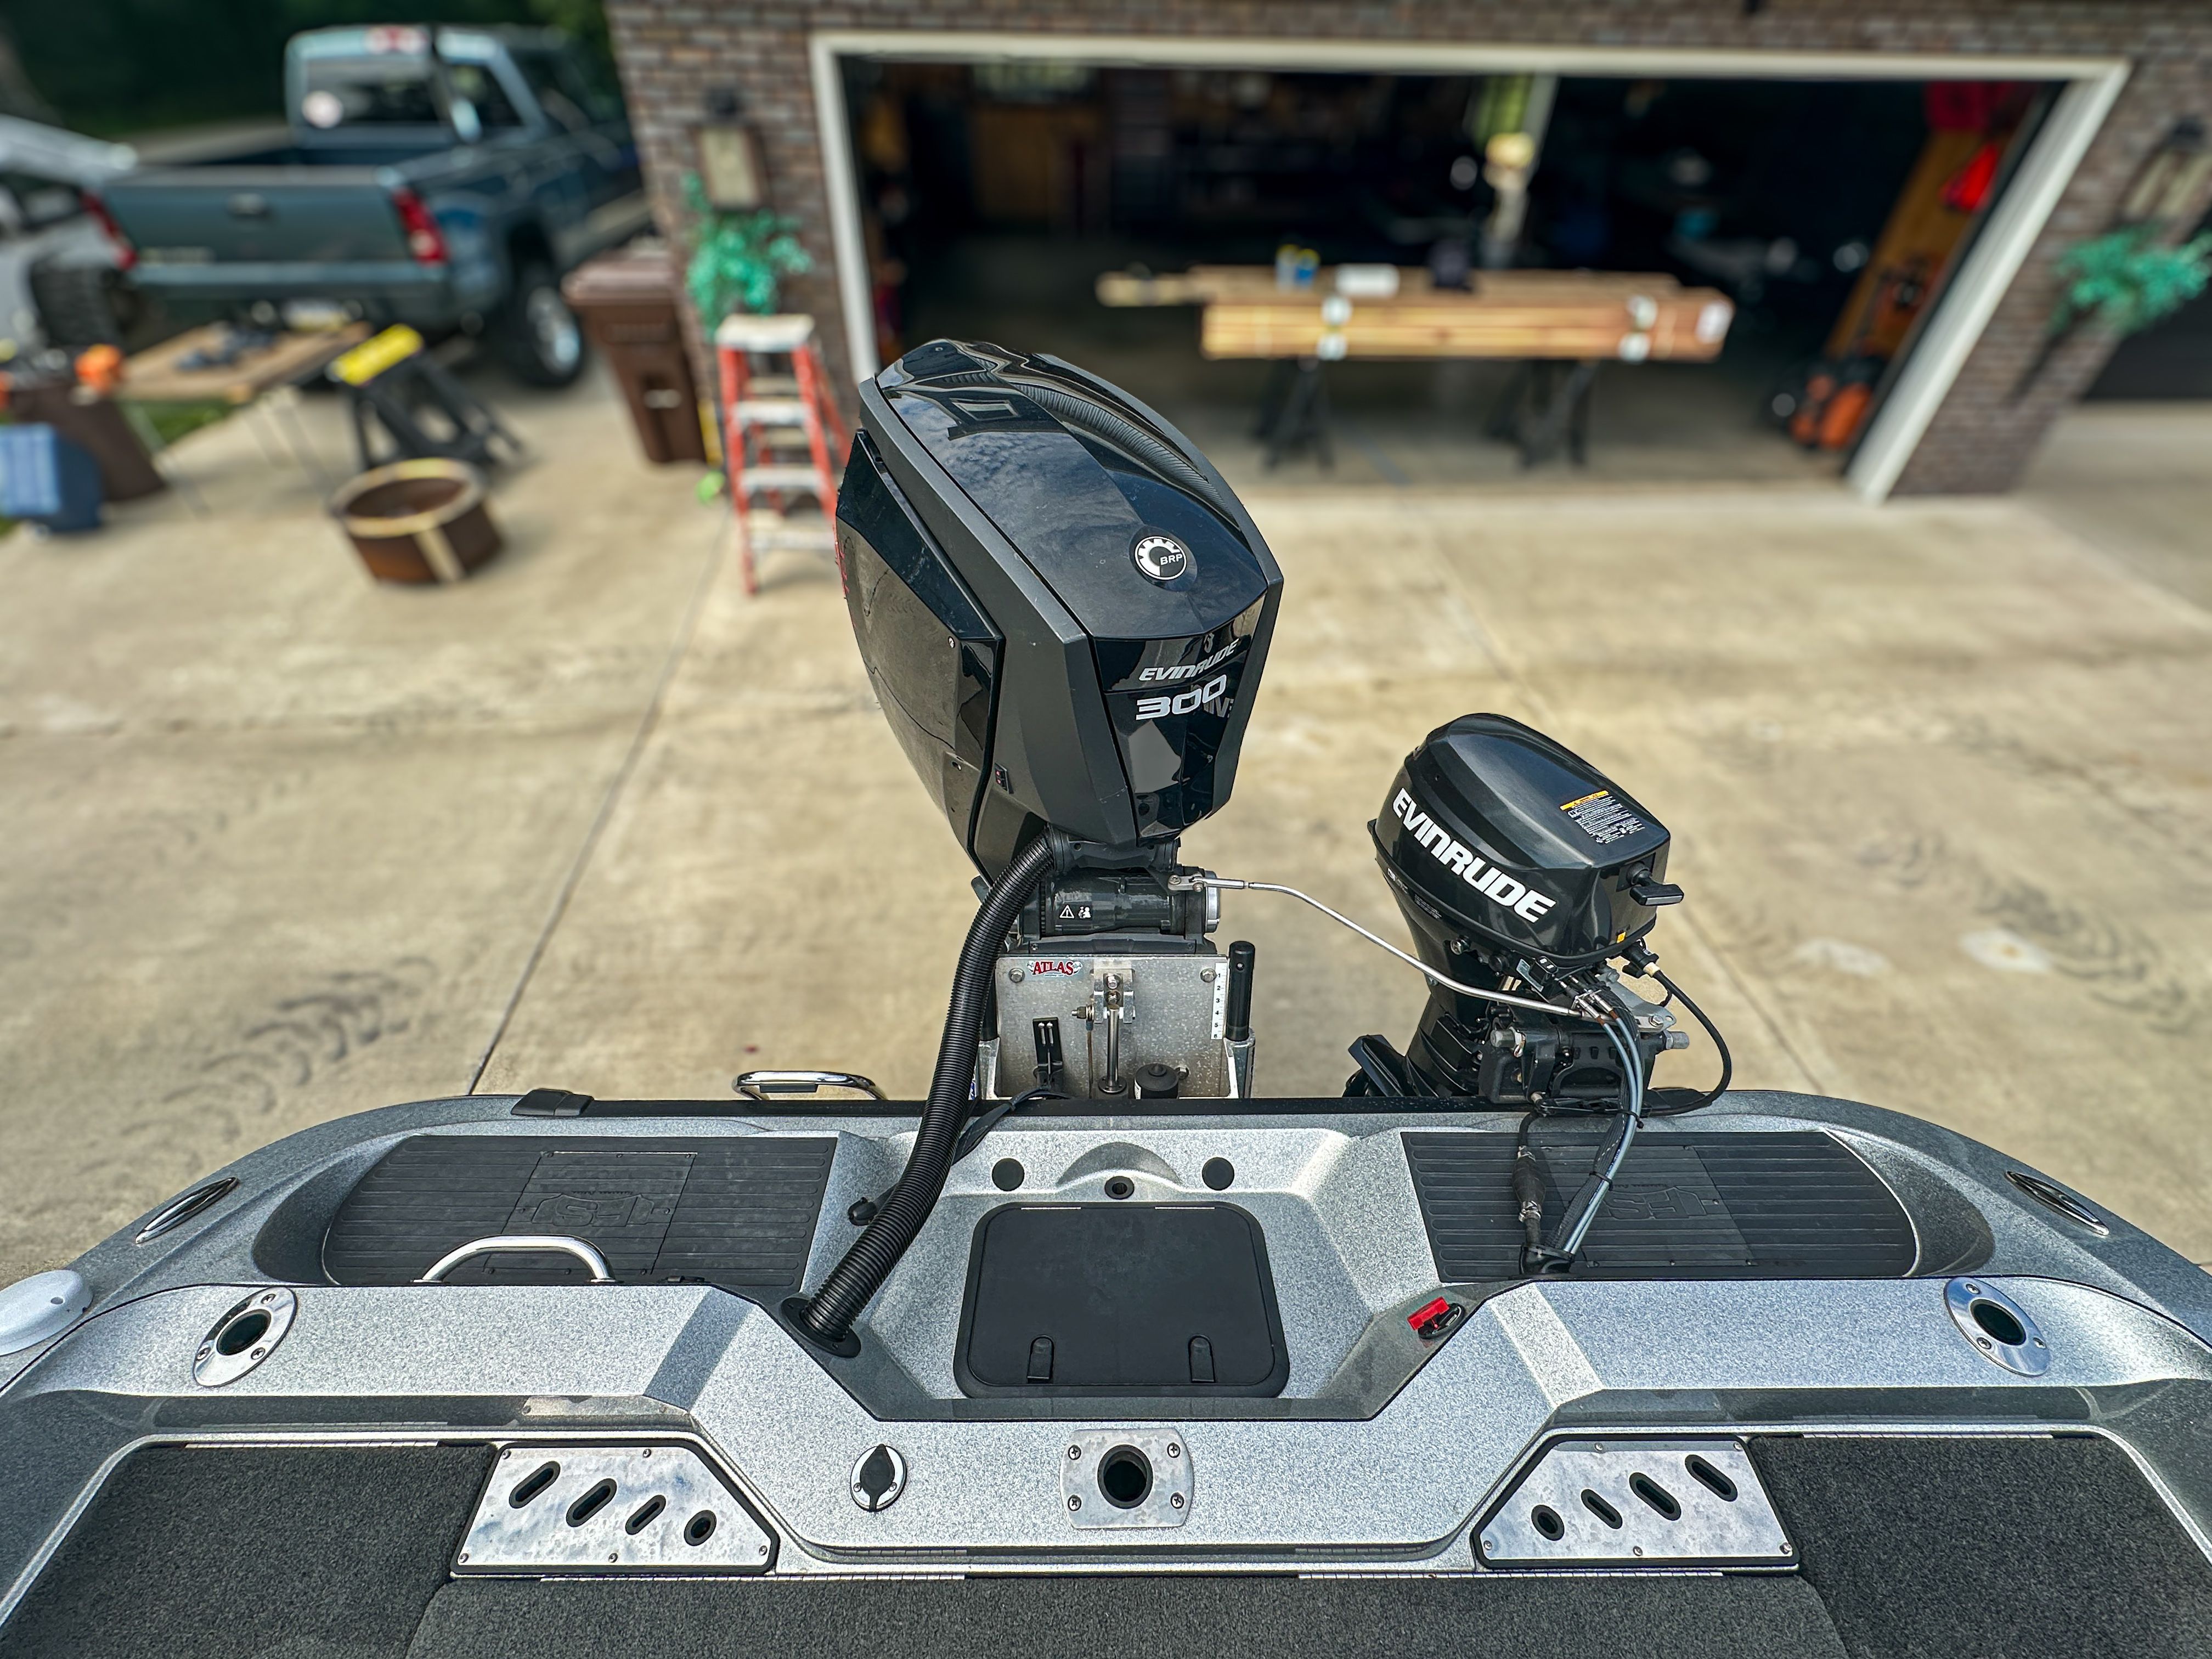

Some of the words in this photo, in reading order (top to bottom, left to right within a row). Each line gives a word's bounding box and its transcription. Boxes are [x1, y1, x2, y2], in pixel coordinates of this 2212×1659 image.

[1160, 552, 1183, 566] BRP
[1138, 638, 1240, 681] EVINRUDE
[1136, 674, 1227, 721] 300
[1392, 788, 1556, 923] EVINRUDE
[1032, 961, 1074, 975] ATLAS
